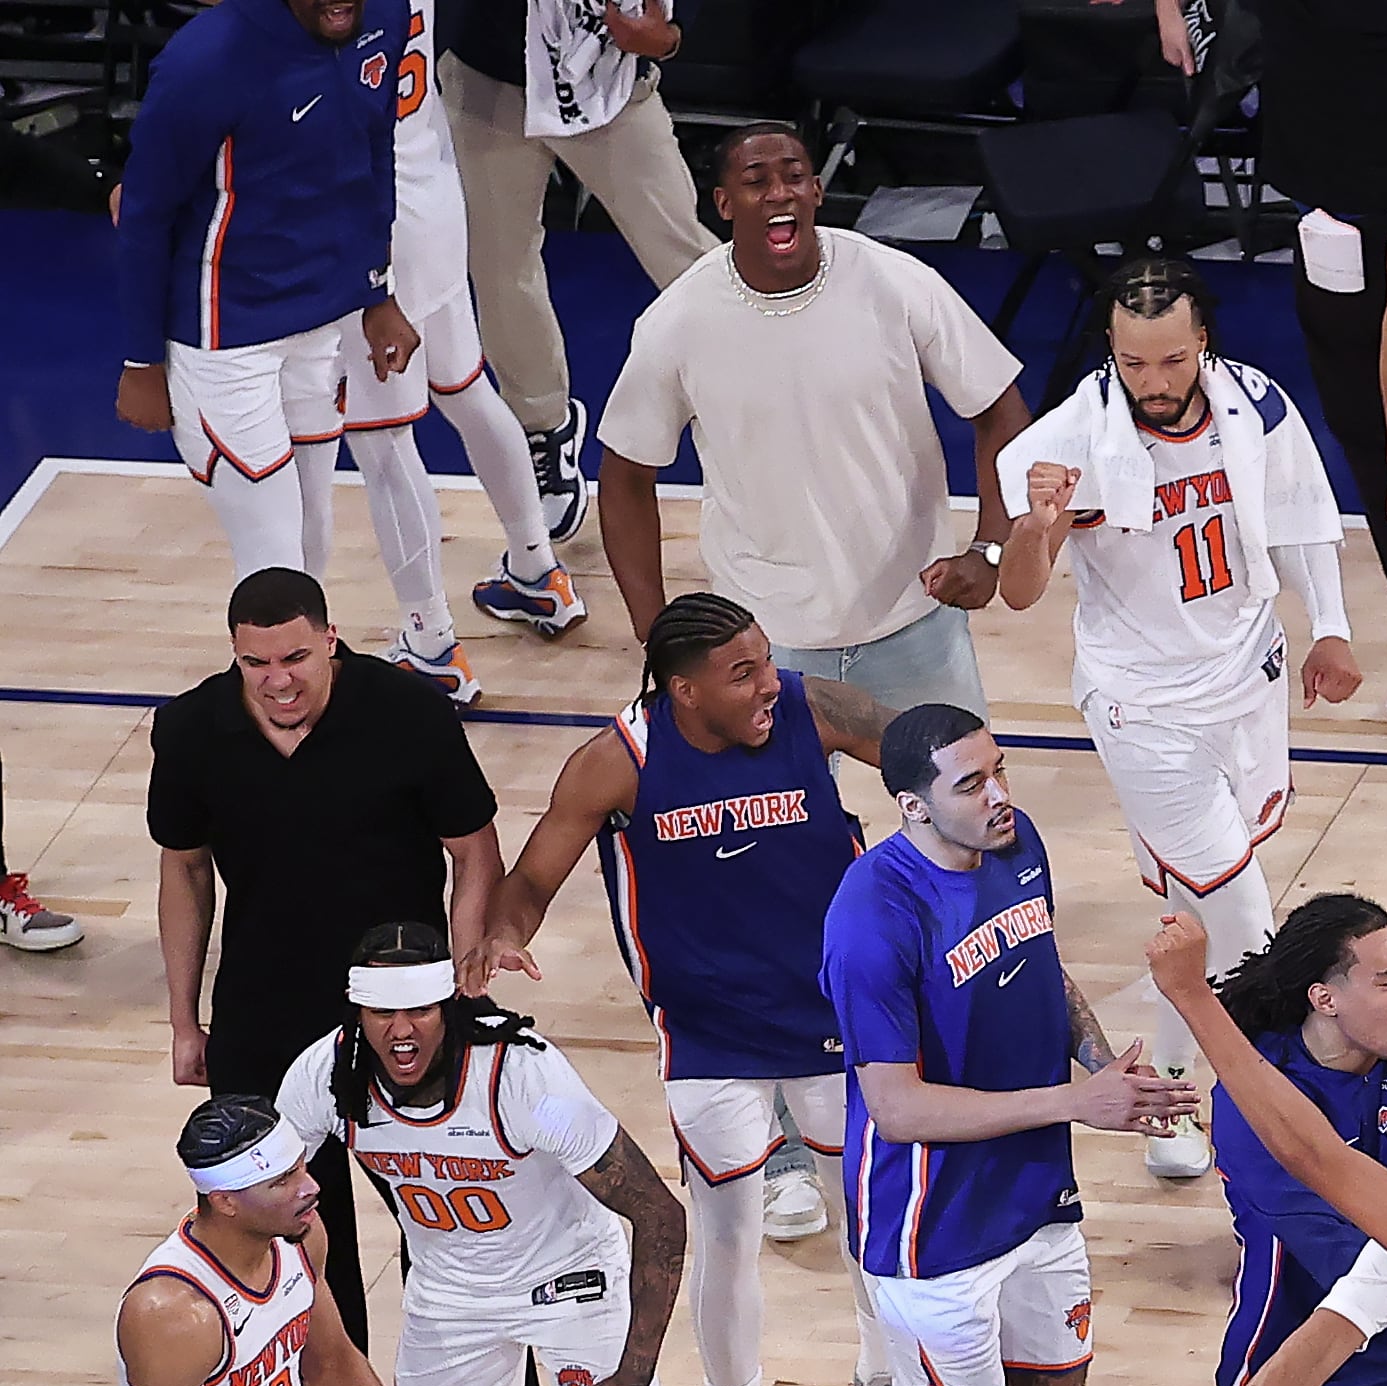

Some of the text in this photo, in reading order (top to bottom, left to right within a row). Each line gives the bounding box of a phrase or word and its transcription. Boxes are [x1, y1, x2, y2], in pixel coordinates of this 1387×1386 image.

[1174, 514, 1234, 604] 11
[654, 789, 809, 841] NEW YORK
[945, 895, 1054, 988] NEW YORK
[423, 1153, 515, 1182] YORK
[395, 1183, 513, 1234] 00
